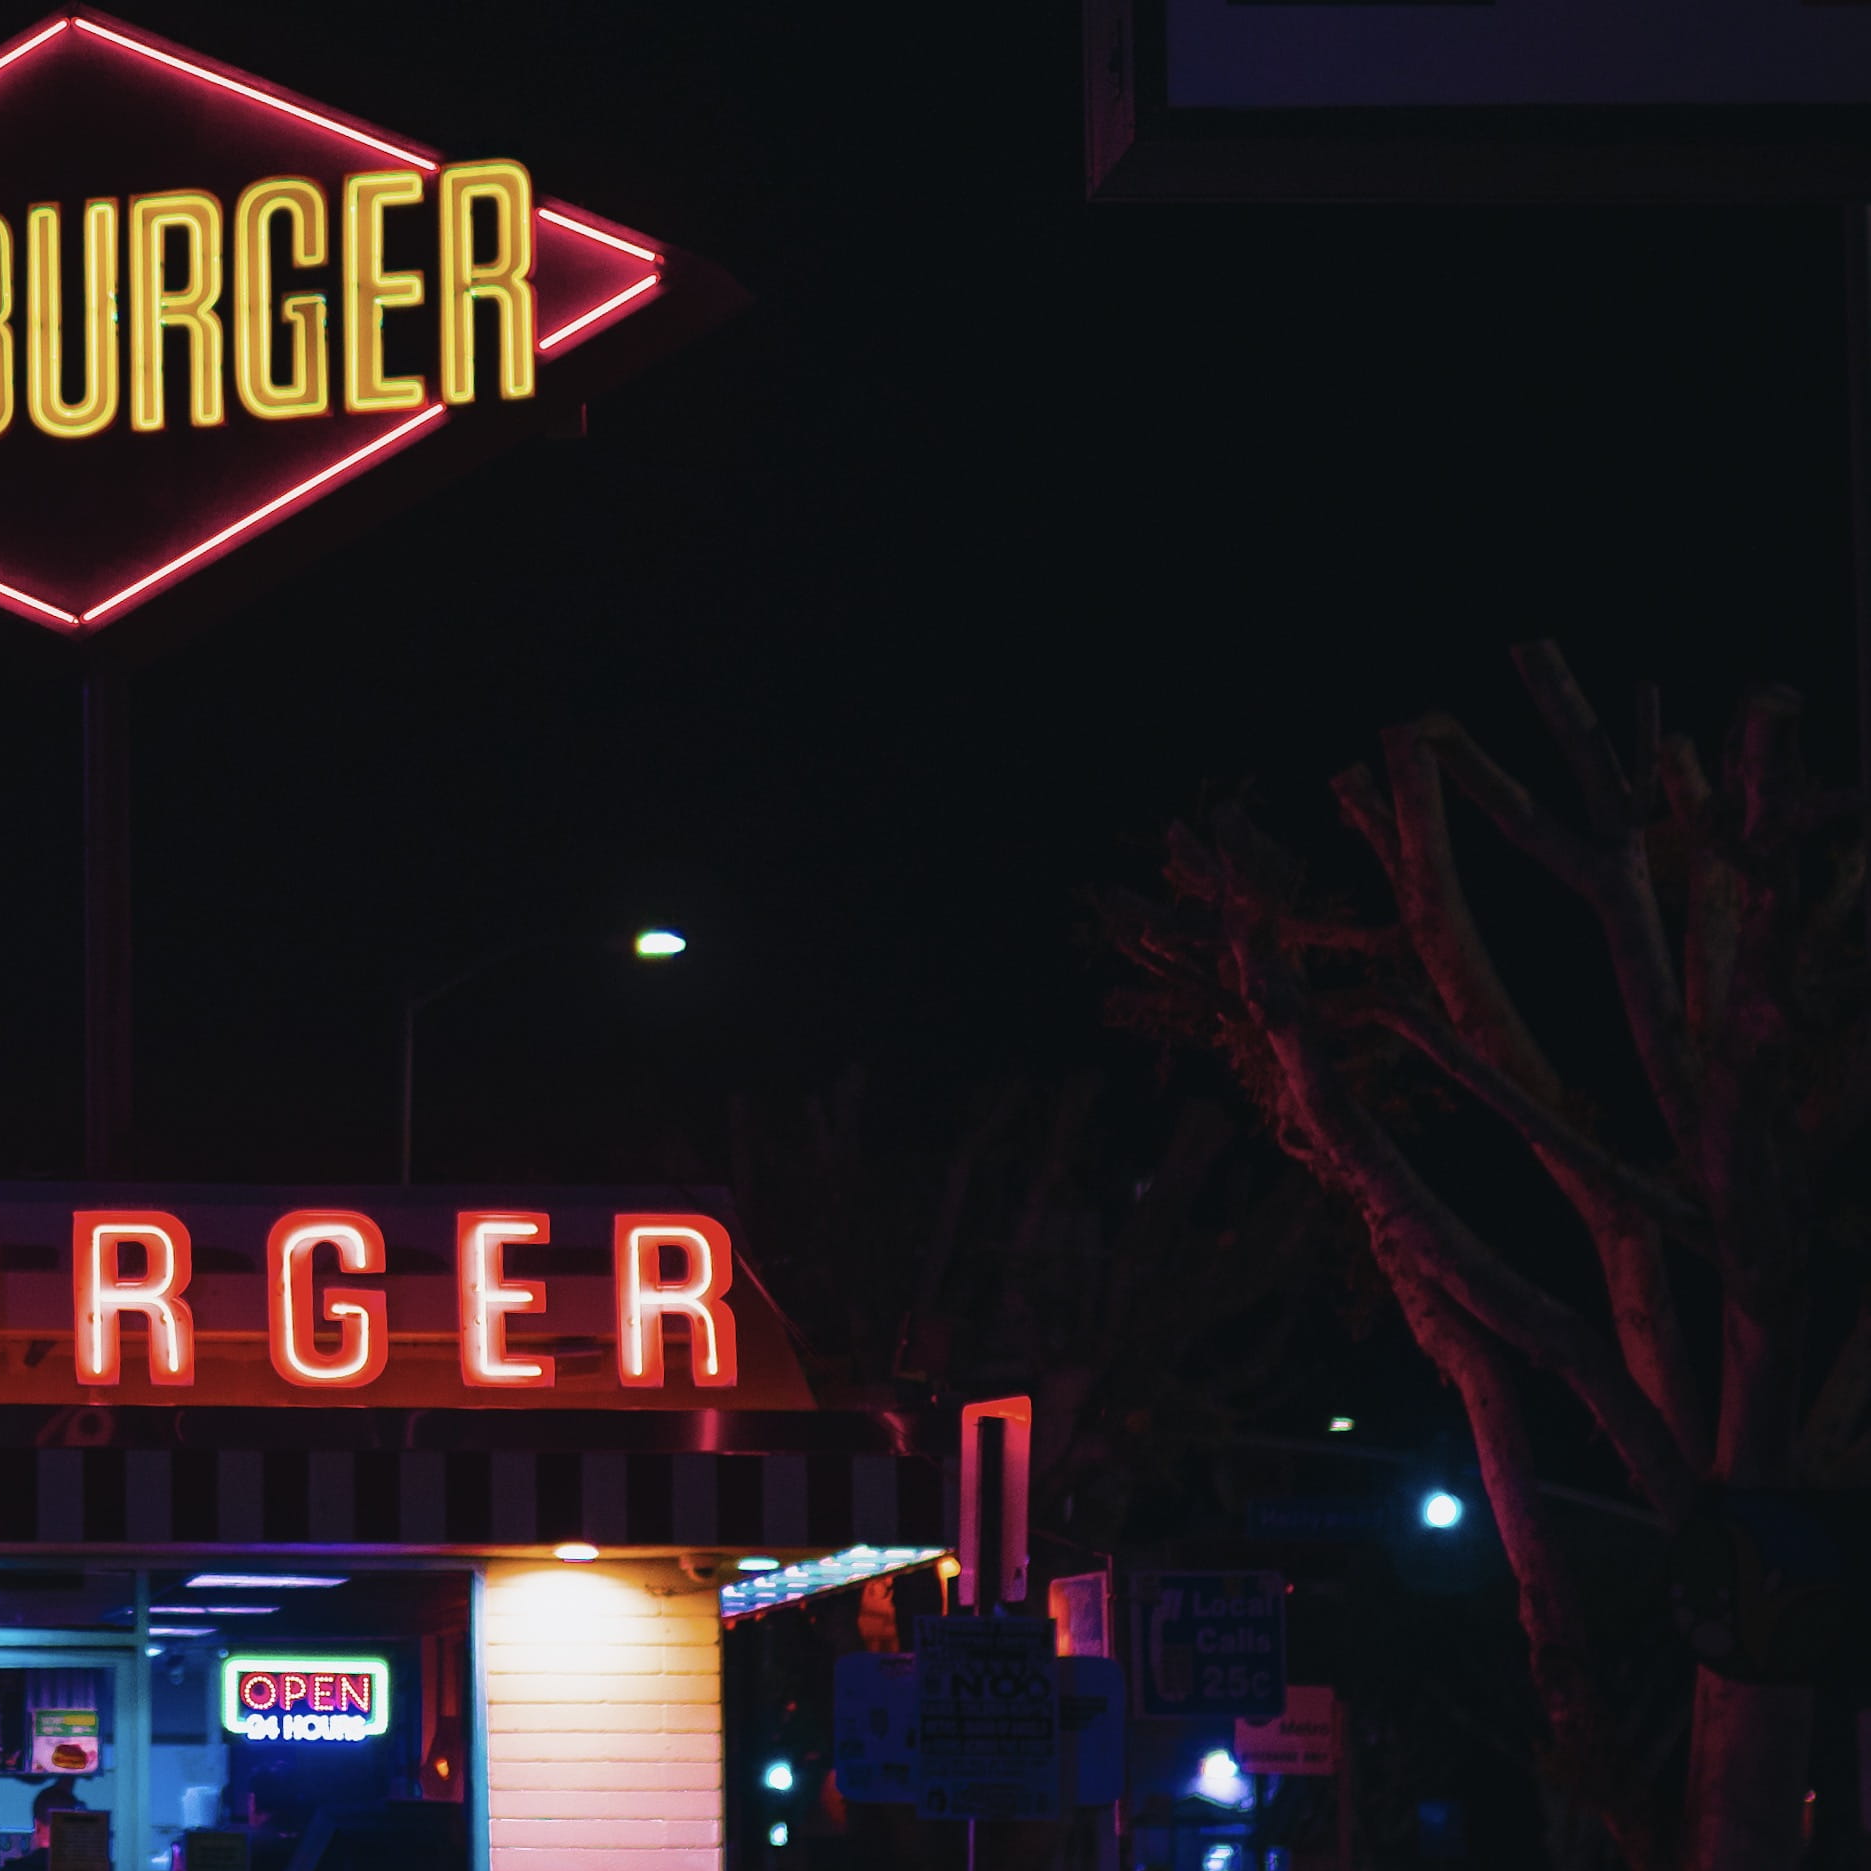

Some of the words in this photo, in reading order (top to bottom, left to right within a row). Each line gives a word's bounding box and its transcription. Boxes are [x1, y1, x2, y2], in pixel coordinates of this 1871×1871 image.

[1192, 1589, 1274, 1617] Local
[1196, 1626, 1272, 1655] Calls
[240, 1672, 371, 1713] OPEN
[246, 1714, 280, 1740] 24
[283, 1714, 367, 1742] HOURS
